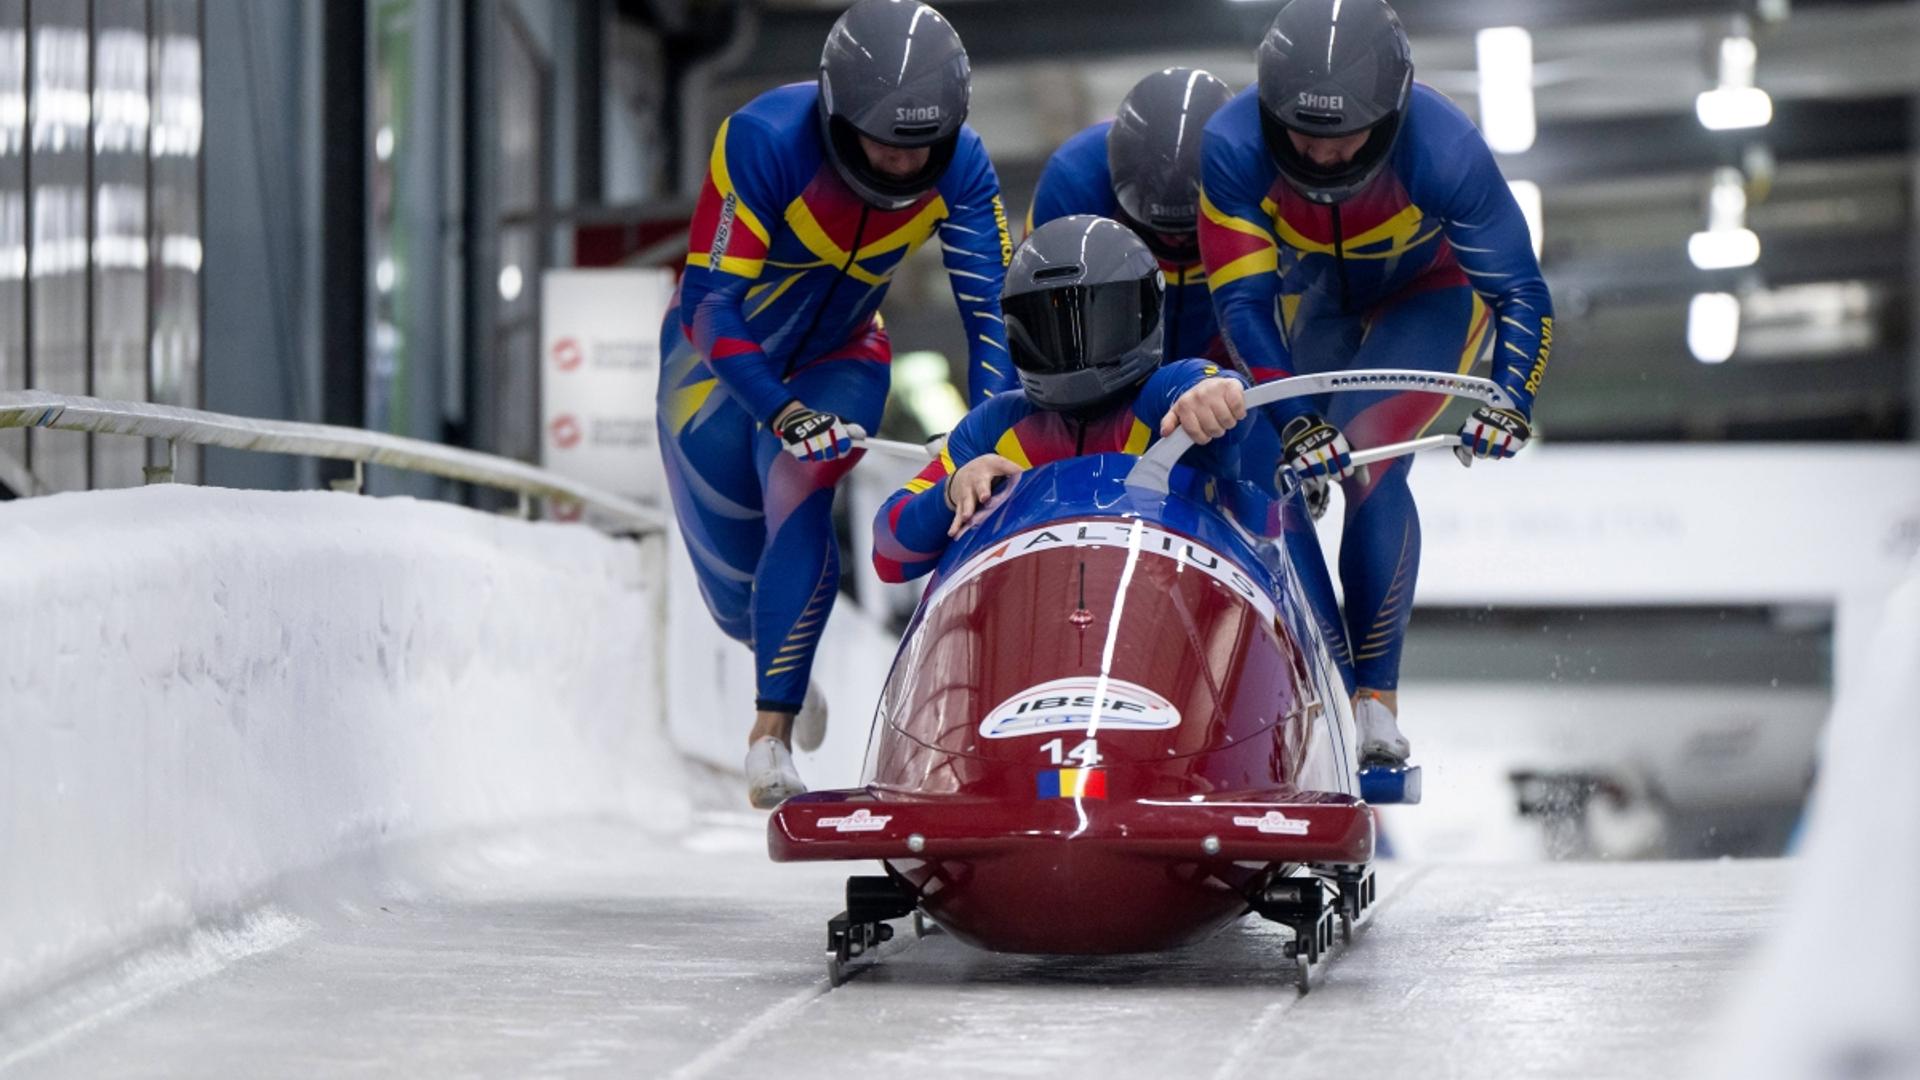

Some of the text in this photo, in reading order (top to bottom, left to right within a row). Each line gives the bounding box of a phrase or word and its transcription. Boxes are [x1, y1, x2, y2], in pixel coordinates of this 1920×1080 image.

[896, 105, 940, 121] SHOEI
[1298, 92, 1343, 109] SHOEI
[1524, 317, 1553, 396] ROMANIA
[795, 415, 831, 438] SEIZ
[1479, 407, 1518, 434] SEIZ
[1295, 429, 1332, 454] SEIZ
[1024, 526, 1254, 598] ALTIUS
[1016, 696, 1146, 715] IBSF
[1040, 738, 1103, 765] 14
